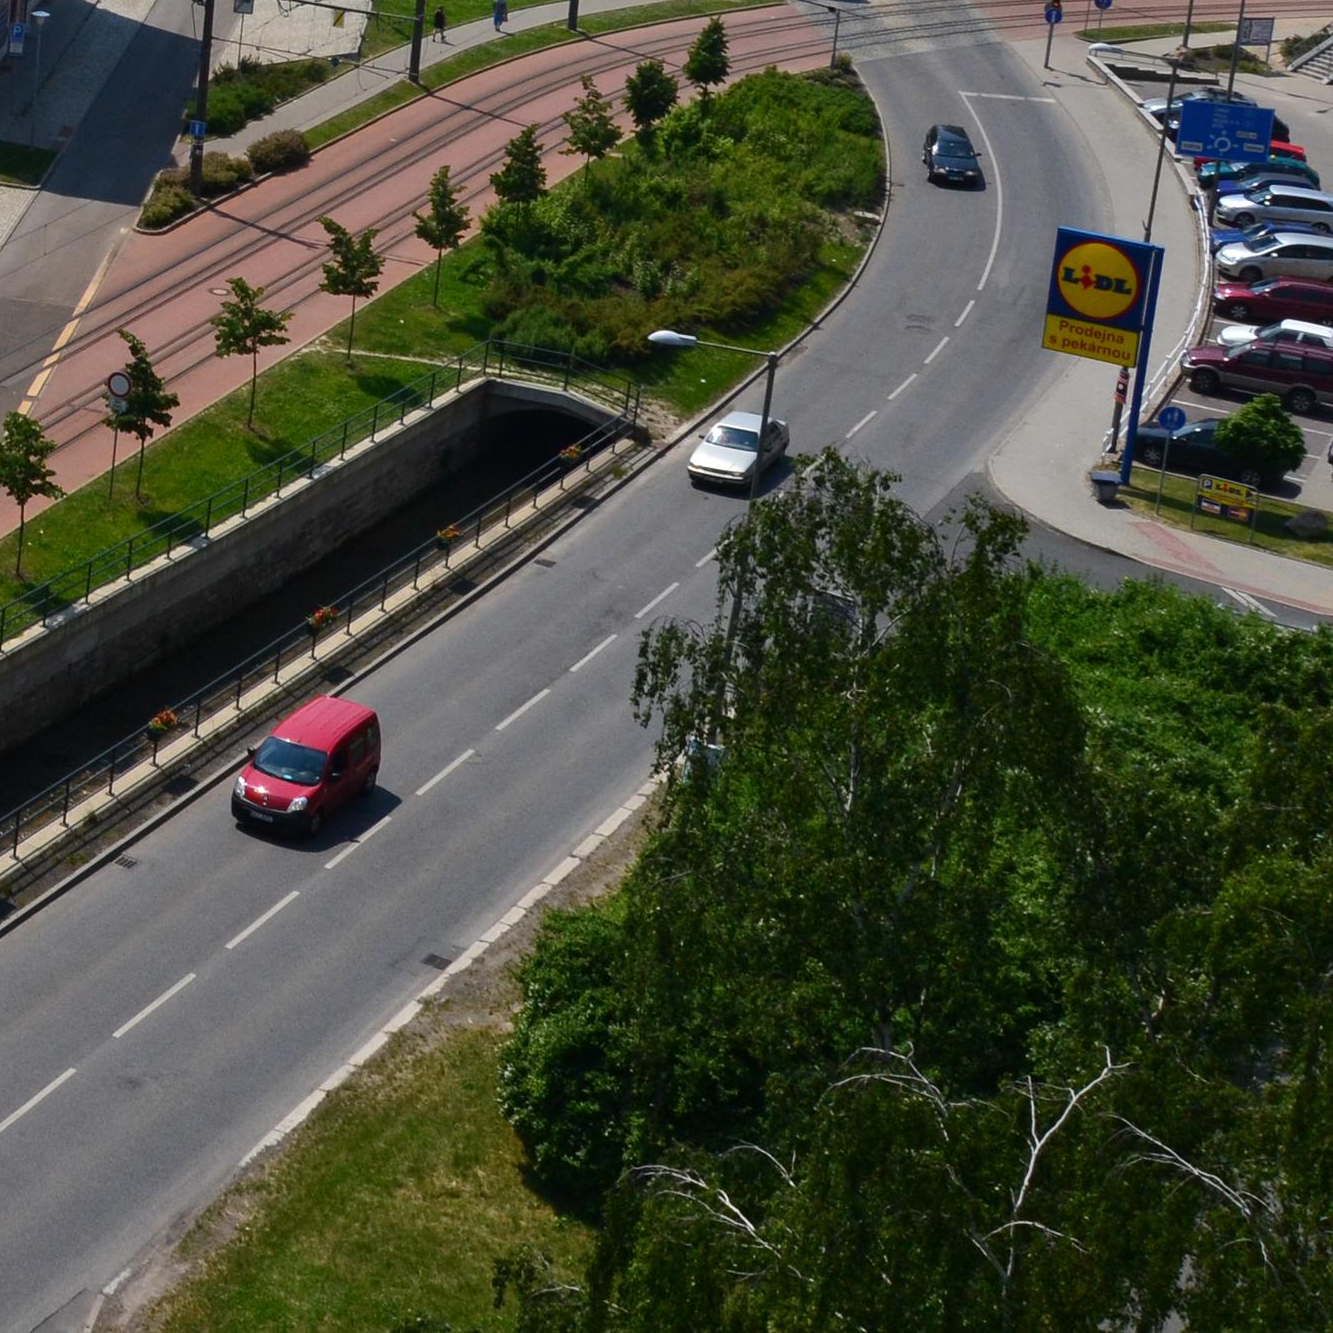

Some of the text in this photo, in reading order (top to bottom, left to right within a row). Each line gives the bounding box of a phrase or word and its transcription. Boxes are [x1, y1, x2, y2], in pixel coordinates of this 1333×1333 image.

[1059, 320, 1125, 345] Prodejna
[1049, 334, 1131, 361] s pekárnou
